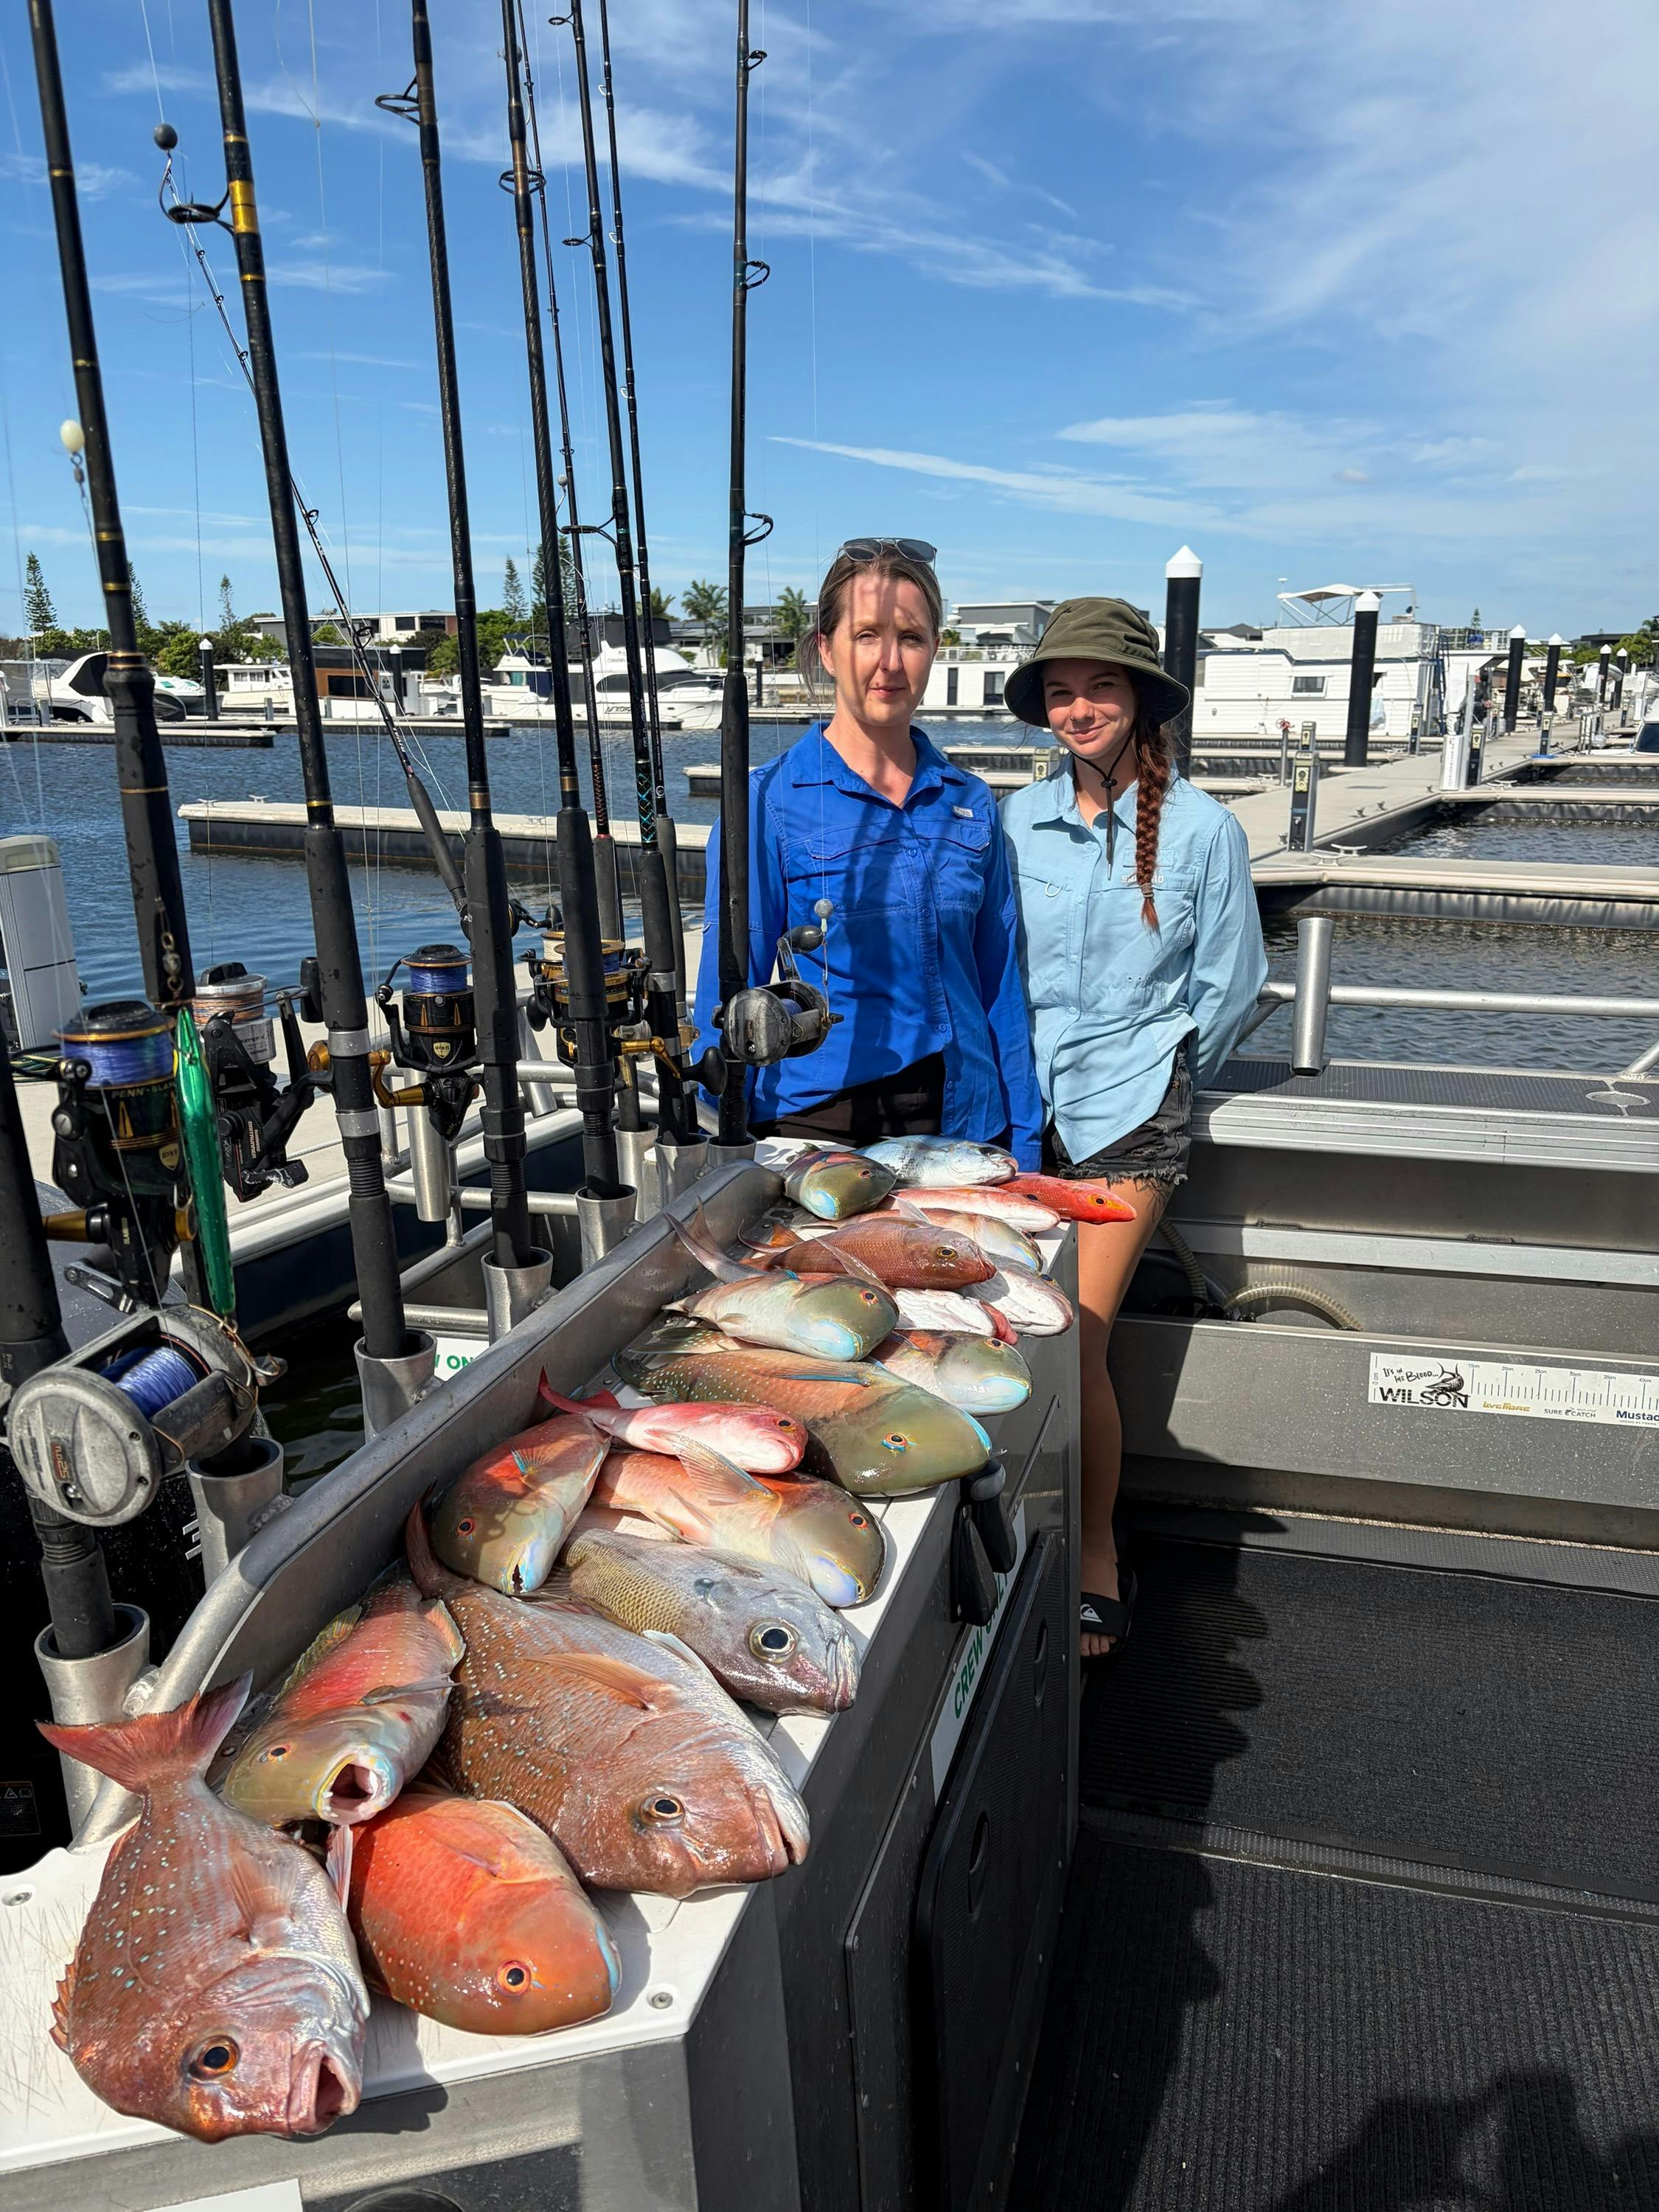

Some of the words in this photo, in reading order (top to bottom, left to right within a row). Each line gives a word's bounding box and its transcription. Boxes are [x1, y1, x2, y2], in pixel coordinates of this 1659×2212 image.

[1121, 874, 1164, 883] SHINO
[1379, 1386, 1469, 1408] WILSON
[1544, 1408, 1562, 1416] SURE
[1571, 1411, 1596, 1419] CATCH
[954, 1625, 984, 1719] CREW
